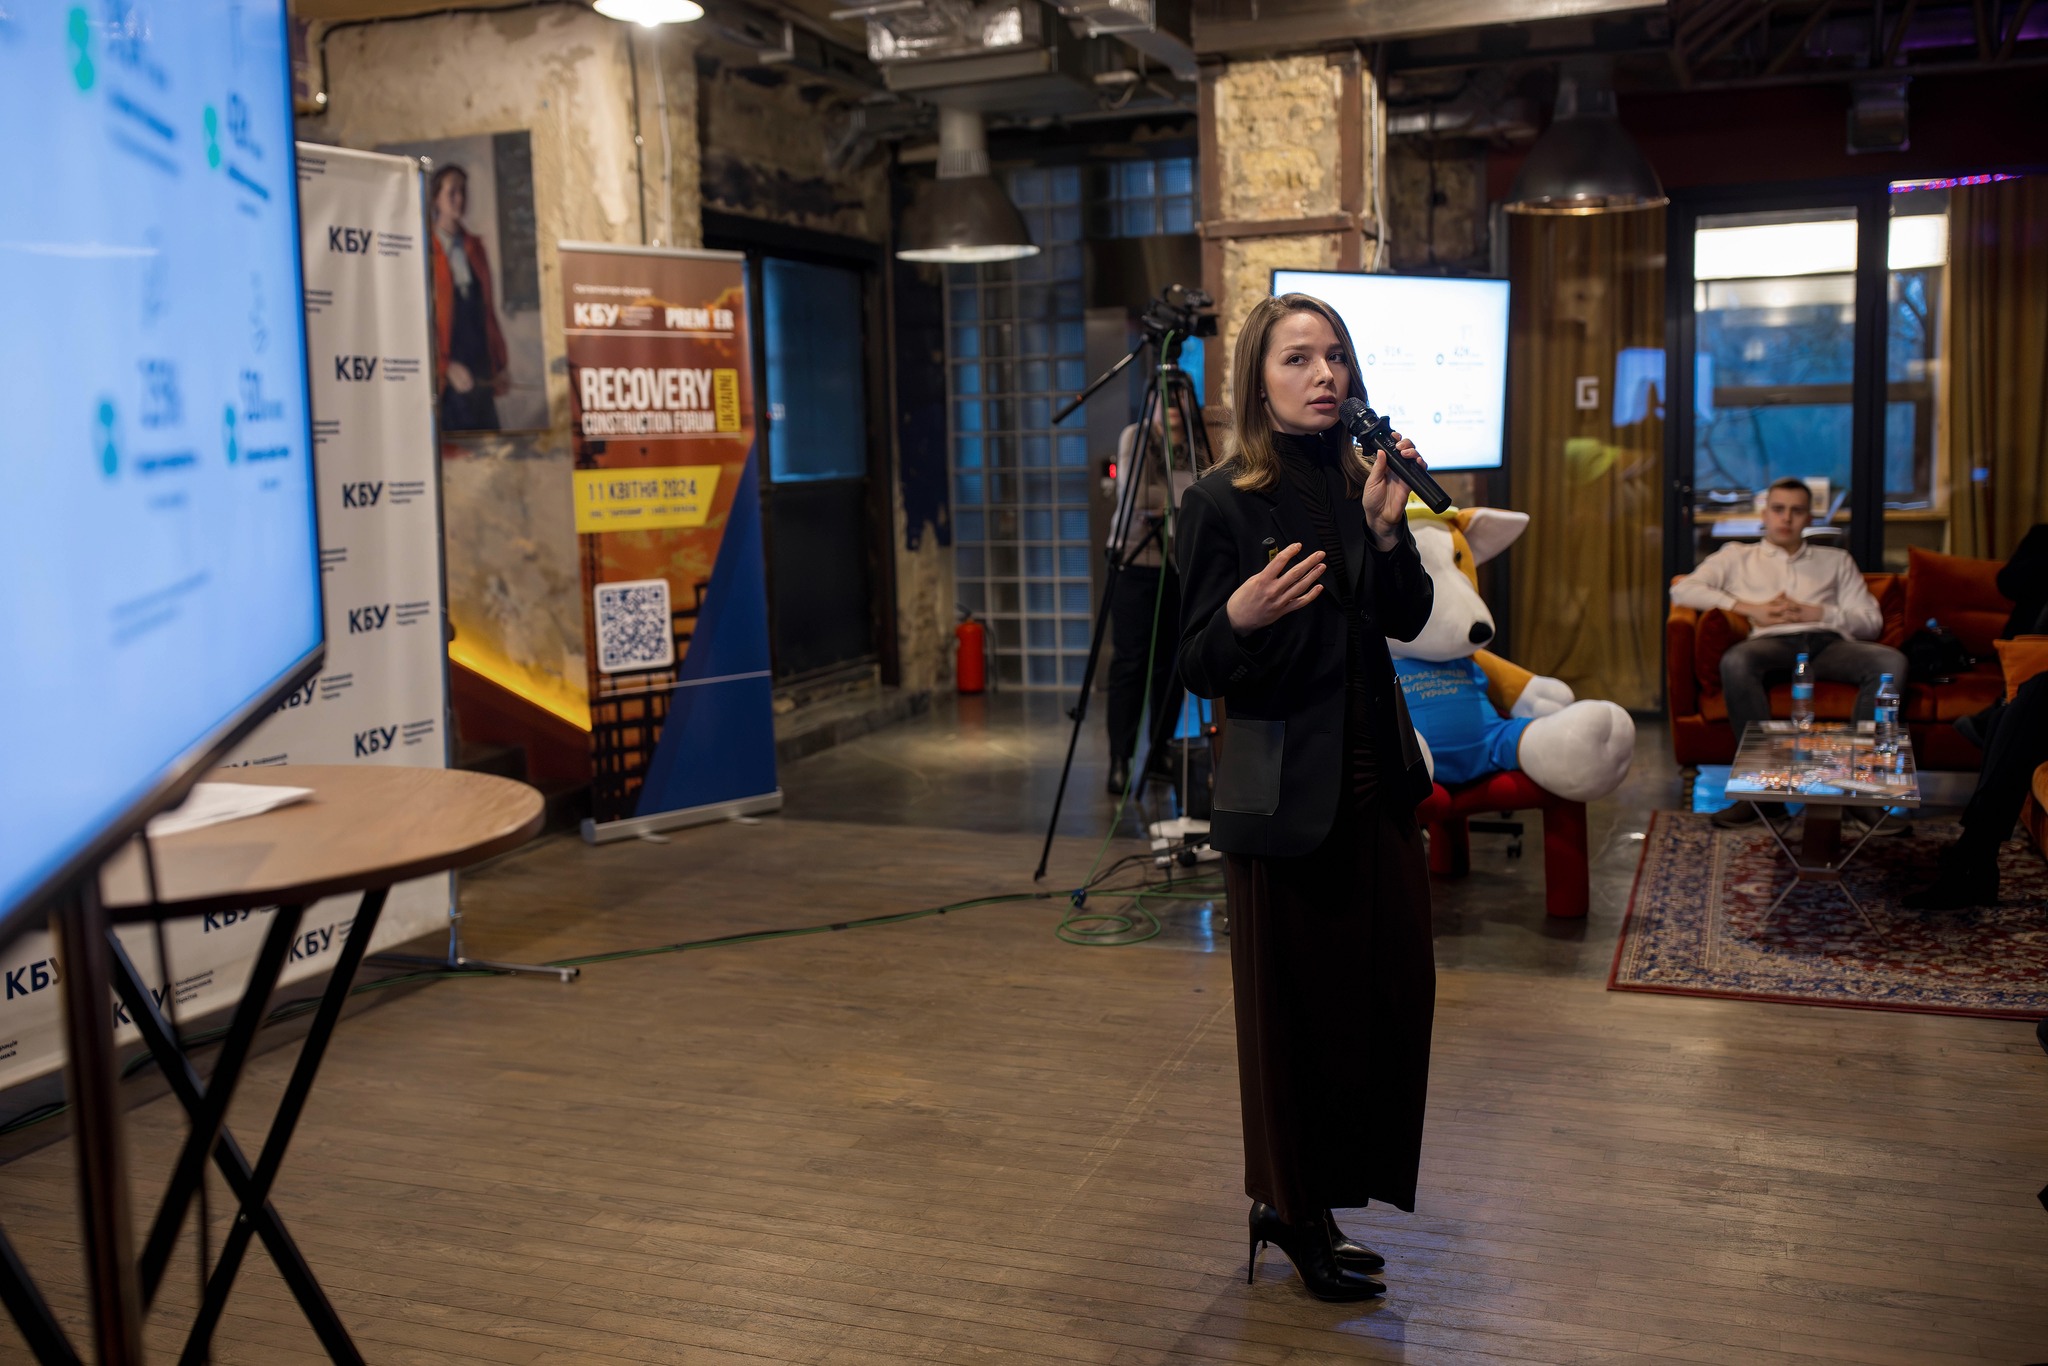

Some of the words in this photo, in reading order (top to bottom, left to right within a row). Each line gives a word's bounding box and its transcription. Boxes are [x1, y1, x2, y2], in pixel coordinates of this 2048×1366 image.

[328, 225, 372, 255] КБУ
[573, 302, 619, 327] КБУ
[335, 355, 377, 382] КБУ
[580, 367, 712, 411] RECOVERY
[581, 412, 672, 436] CONSTRUCTION
[674, 411, 716, 432] FORUM
[342, 480, 384, 509] КБУ
[662, 478, 698, 499] 2024
[348, 603, 390, 634] КБУ
[354, 724, 398, 758] КБУ
[289, 924, 335, 963] КБУ
